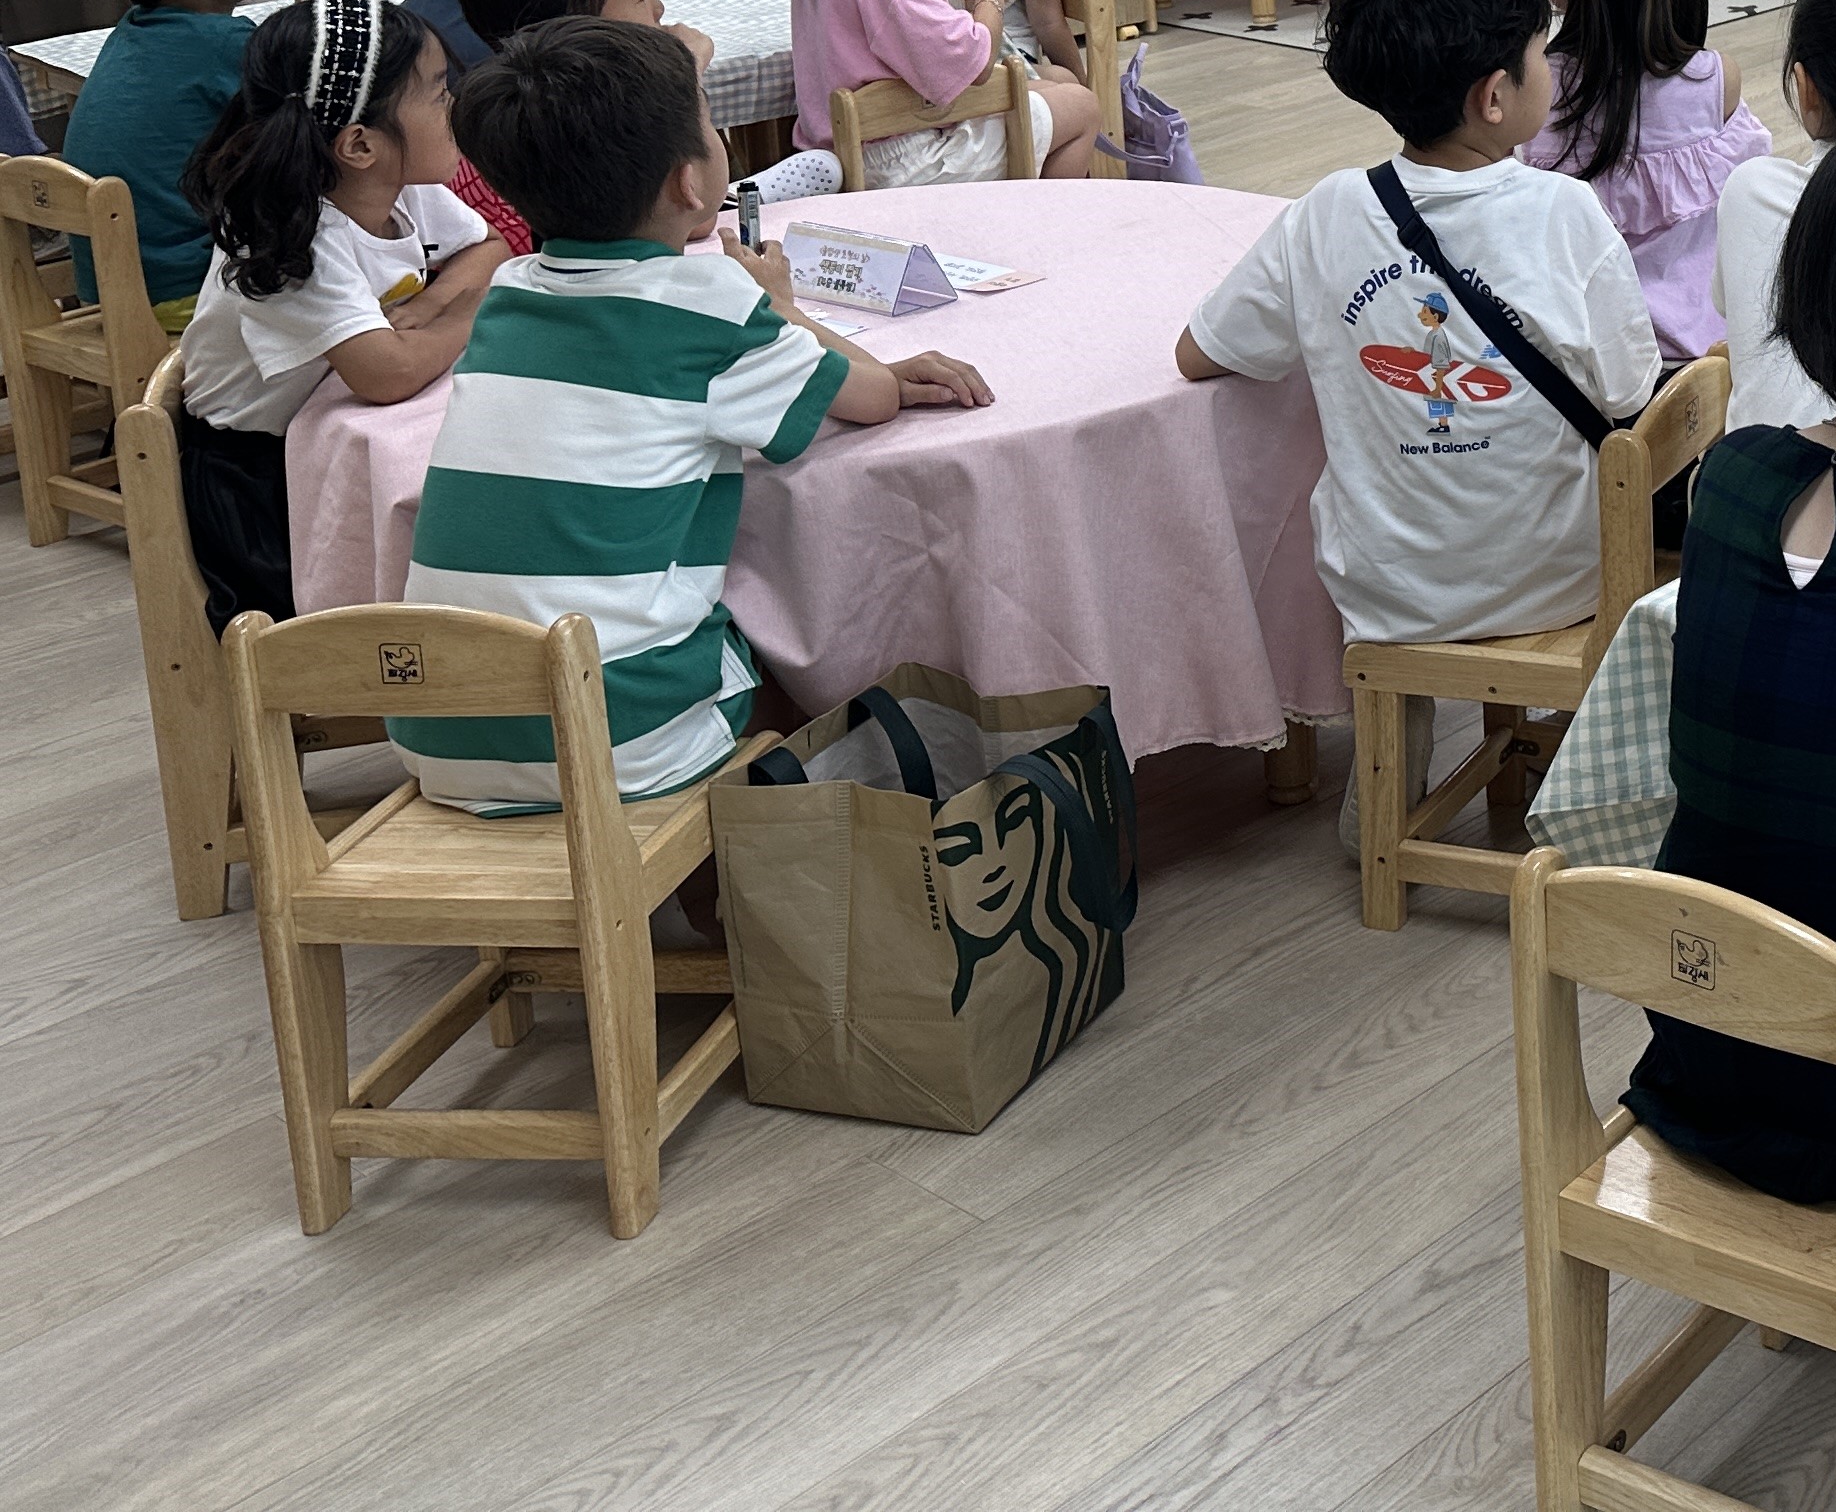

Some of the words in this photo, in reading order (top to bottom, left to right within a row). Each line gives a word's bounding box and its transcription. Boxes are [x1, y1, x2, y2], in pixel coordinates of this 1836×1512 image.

[1341, 260, 1402, 326] inspire
[1371, 360, 1413, 386] Surfing
[1400, 443, 1429, 455] New
[1432, 439, 1490, 454] Balance
[918, 845, 941, 932] STARBUCKS
